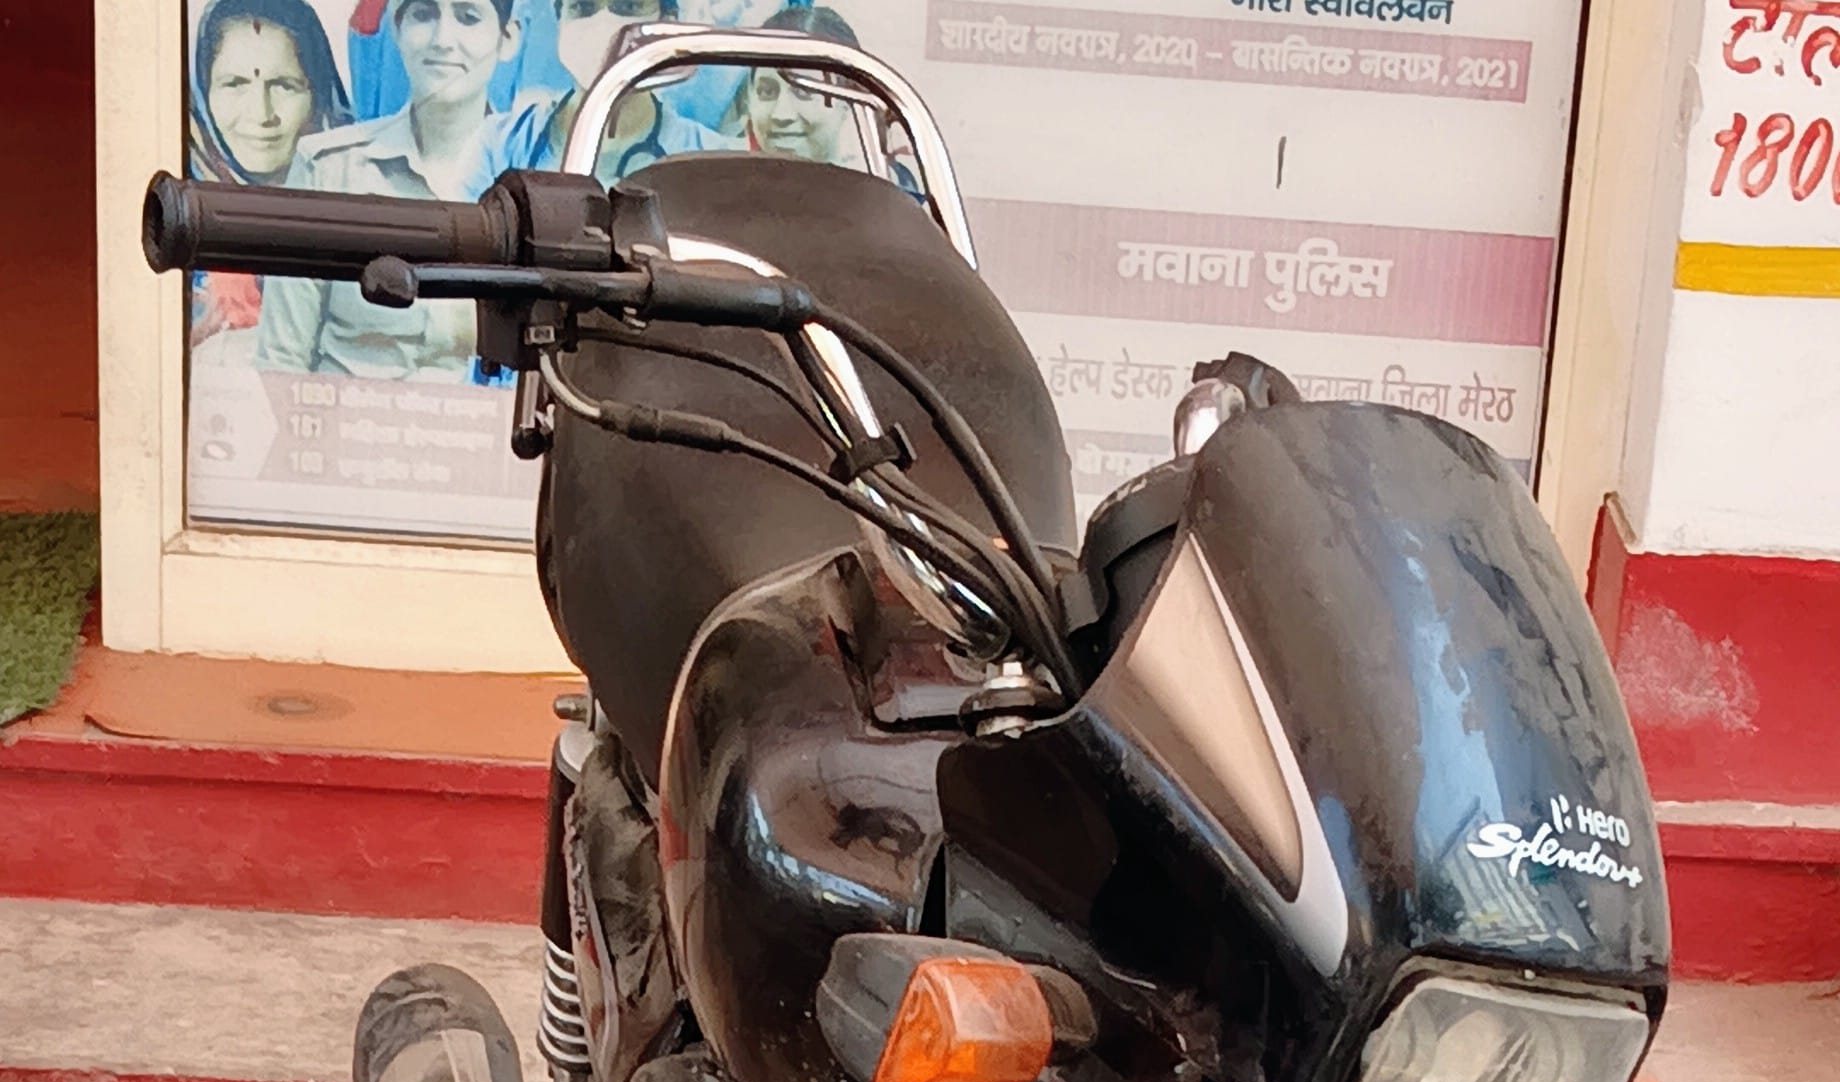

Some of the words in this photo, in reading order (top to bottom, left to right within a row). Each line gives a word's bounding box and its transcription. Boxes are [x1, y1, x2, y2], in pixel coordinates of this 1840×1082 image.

[1455, 56, 1519, 89] 2021
[1711, 112, 1840, 205] 180
[1117, 241, 1254, 288] मवाना
[1263, 237, 1394, 314] पुलिस
[1047, 343, 1105, 397] हेल्प
[1111, 347, 1177, 400] डेस्क
[1459, 371, 1517, 423] मेरठ
